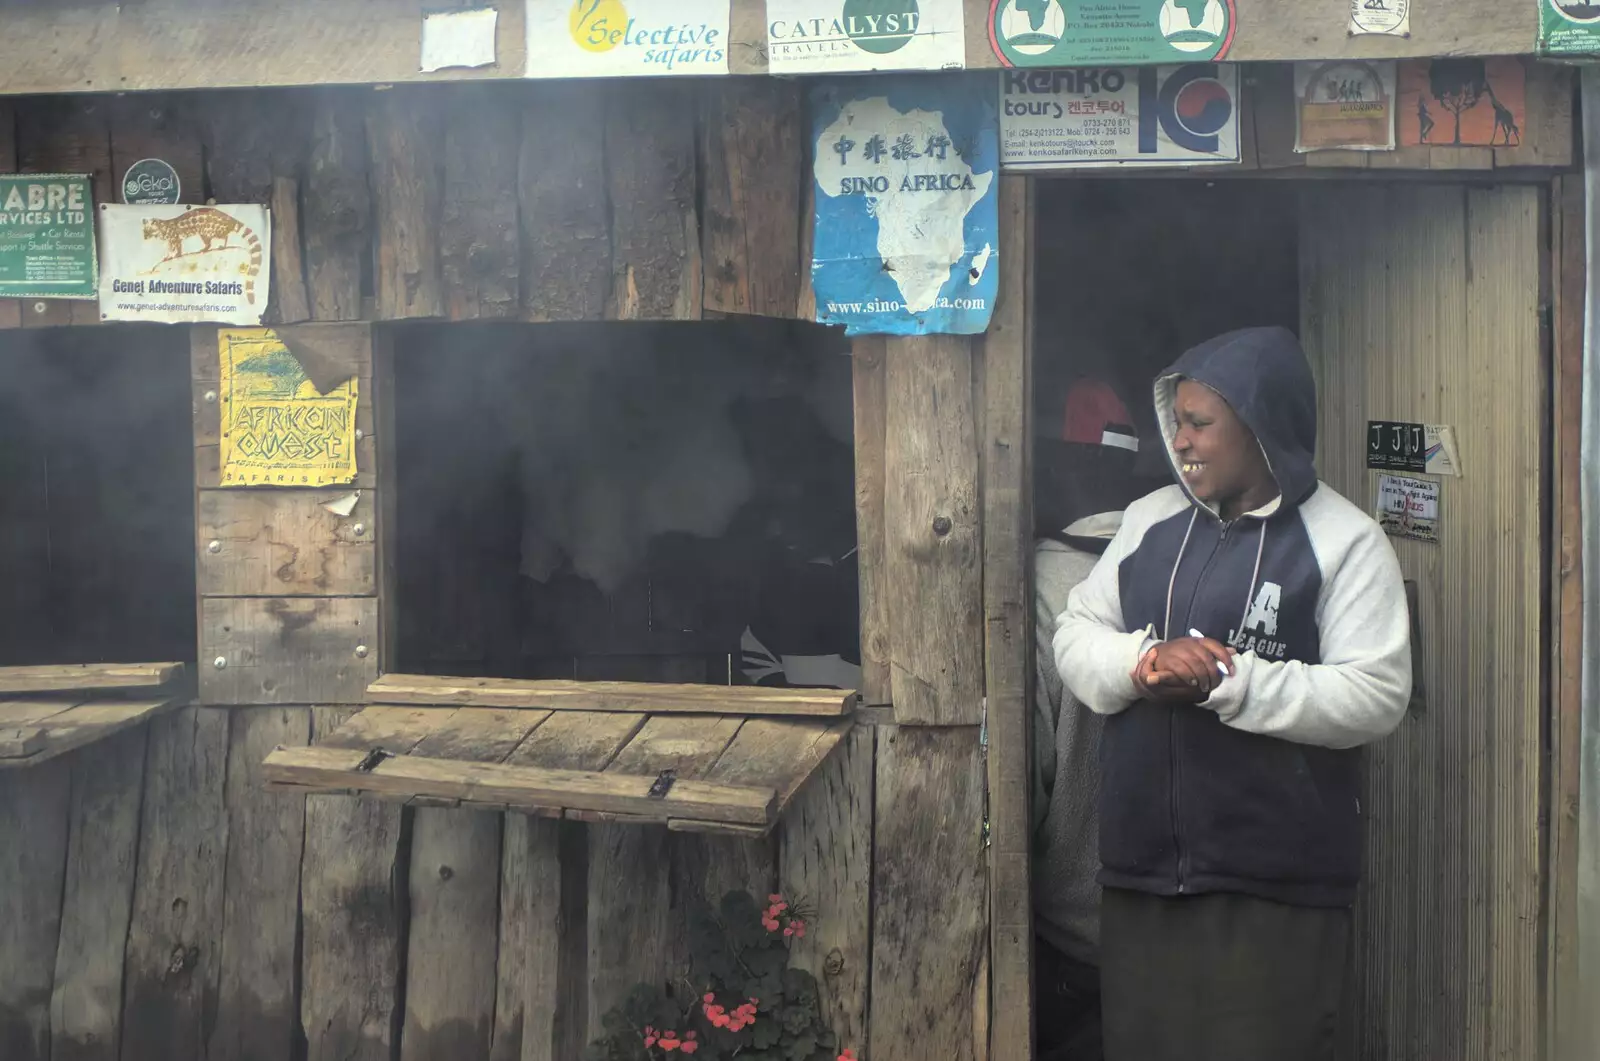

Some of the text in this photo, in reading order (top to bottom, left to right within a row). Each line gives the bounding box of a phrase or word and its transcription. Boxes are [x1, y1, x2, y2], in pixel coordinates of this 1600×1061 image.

[587, 18, 719, 46] Selective
[769, 12, 919, 39] CATALYST
[643, 44, 724, 70] safaris
[771, 42, 850, 55] TRAVELS
[1005, 99, 1064, 119] tours
[1068, 100, 1125, 115] 켄코투어
[840, 174, 976, 194] SINO AFRICA
[57, 212, 85, 225] LTD
[113, 279, 243, 296] Genet Adventure Safaris
[117, 301, 237, 313] www.genet-adventuresafaris.com
[826, 297, 986, 314] www.sino-ca.com
[226, 473, 308, 482] SAFARIS
[1244, 581, 1282, 636] A
[1227, 628, 1287, 658] LEAGUE
